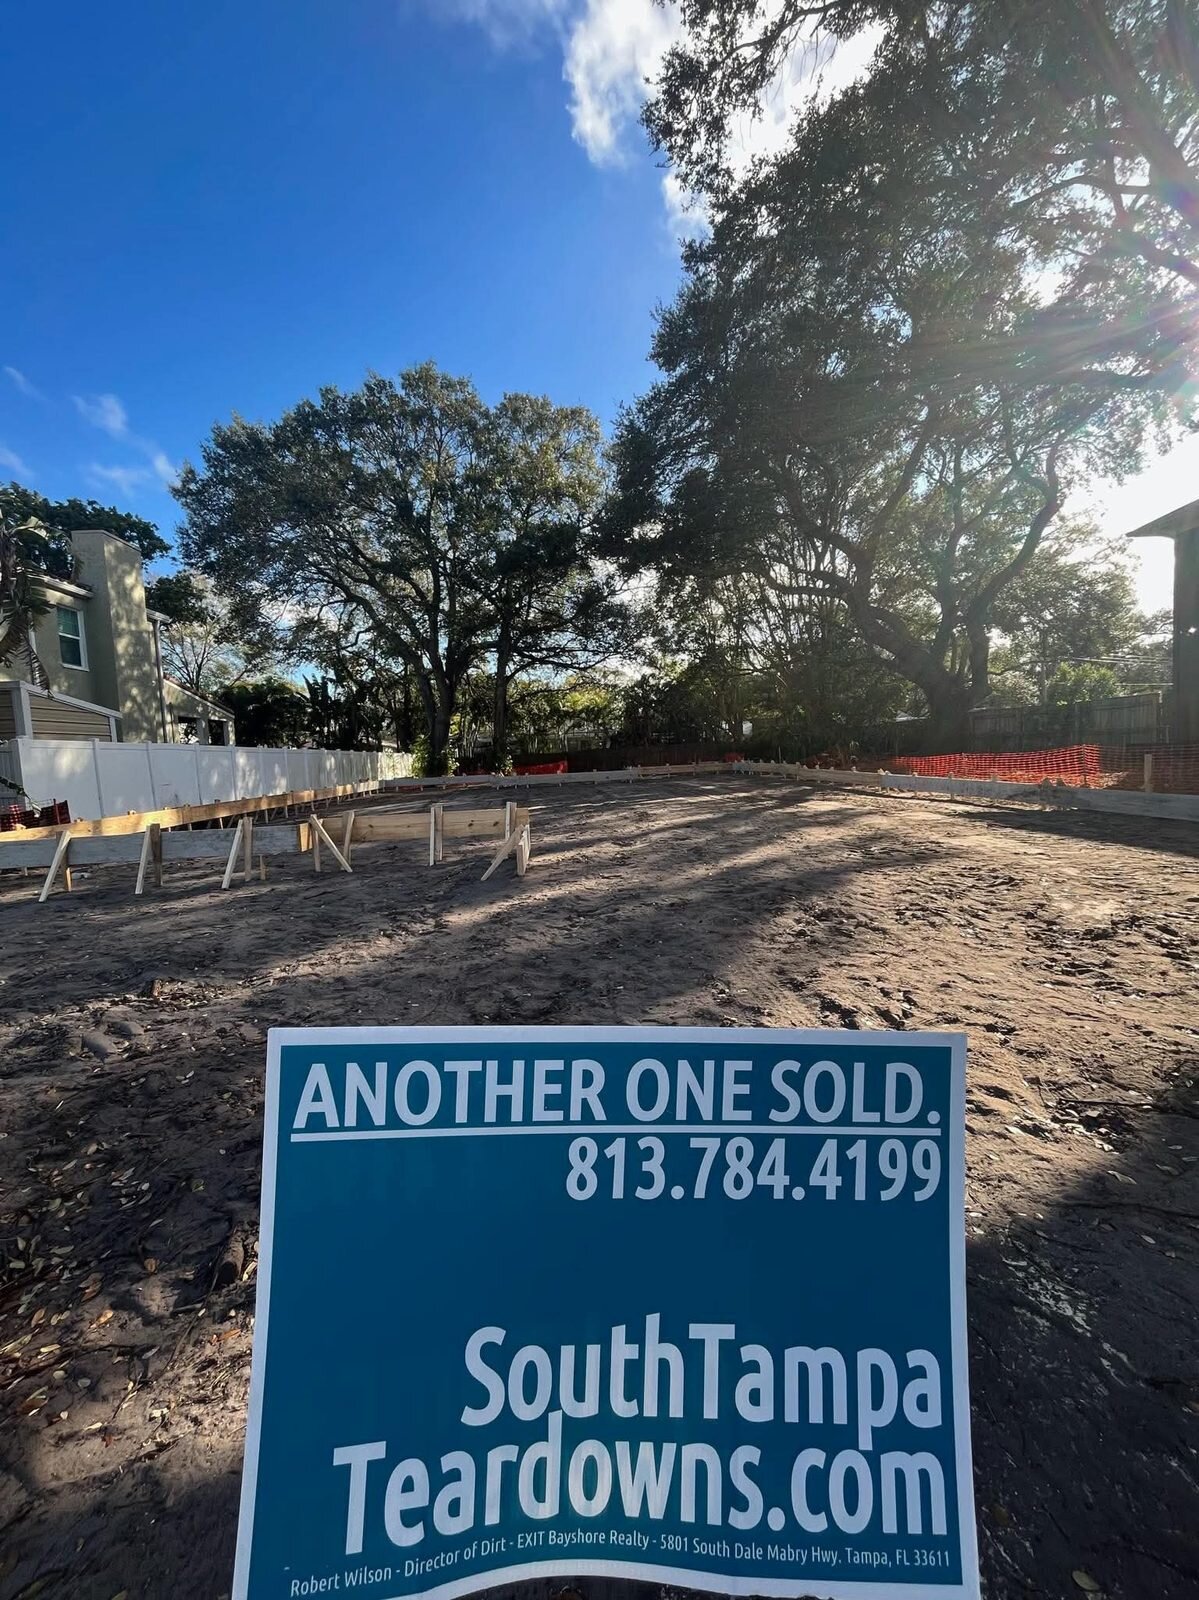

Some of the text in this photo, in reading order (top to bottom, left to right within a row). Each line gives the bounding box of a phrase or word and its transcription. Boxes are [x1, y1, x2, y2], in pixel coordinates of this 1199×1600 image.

[293, 1059, 941, 1128] ANOTHER ONE SOLD.
[566, 1137, 941, 1201] 813.784.4199
[460, 1313, 942, 1451] SouthTampa
[332, 1410, 947, 1555] Teardowns.com
[290, 1574, 340, 1597] Robert
[344, 1566, 392, 1588] Wilson
[404, 1550, 460, 1577] Director
[464, 1541, 478, 1560] of
[481, 1537, 506, 1556] Dirt
[517, 1531, 545, 1549] EXIT
[549, 1528, 605, 1549] Bayshore
[610, 1530, 649, 1550] Realty
[661, 1534, 688, 1552] 5801
[693, 1538, 730, 1558] South
[735, 1543, 763, 1560] Dale
[768, 1545, 808, 1565] Mabry
[812, 1547, 841, 1566] Hwy.
[845, 1548, 891, 1568] Tampa,
[896, 1549, 910, 1566] FL
[913, 1550, 949, 1567] 33611
